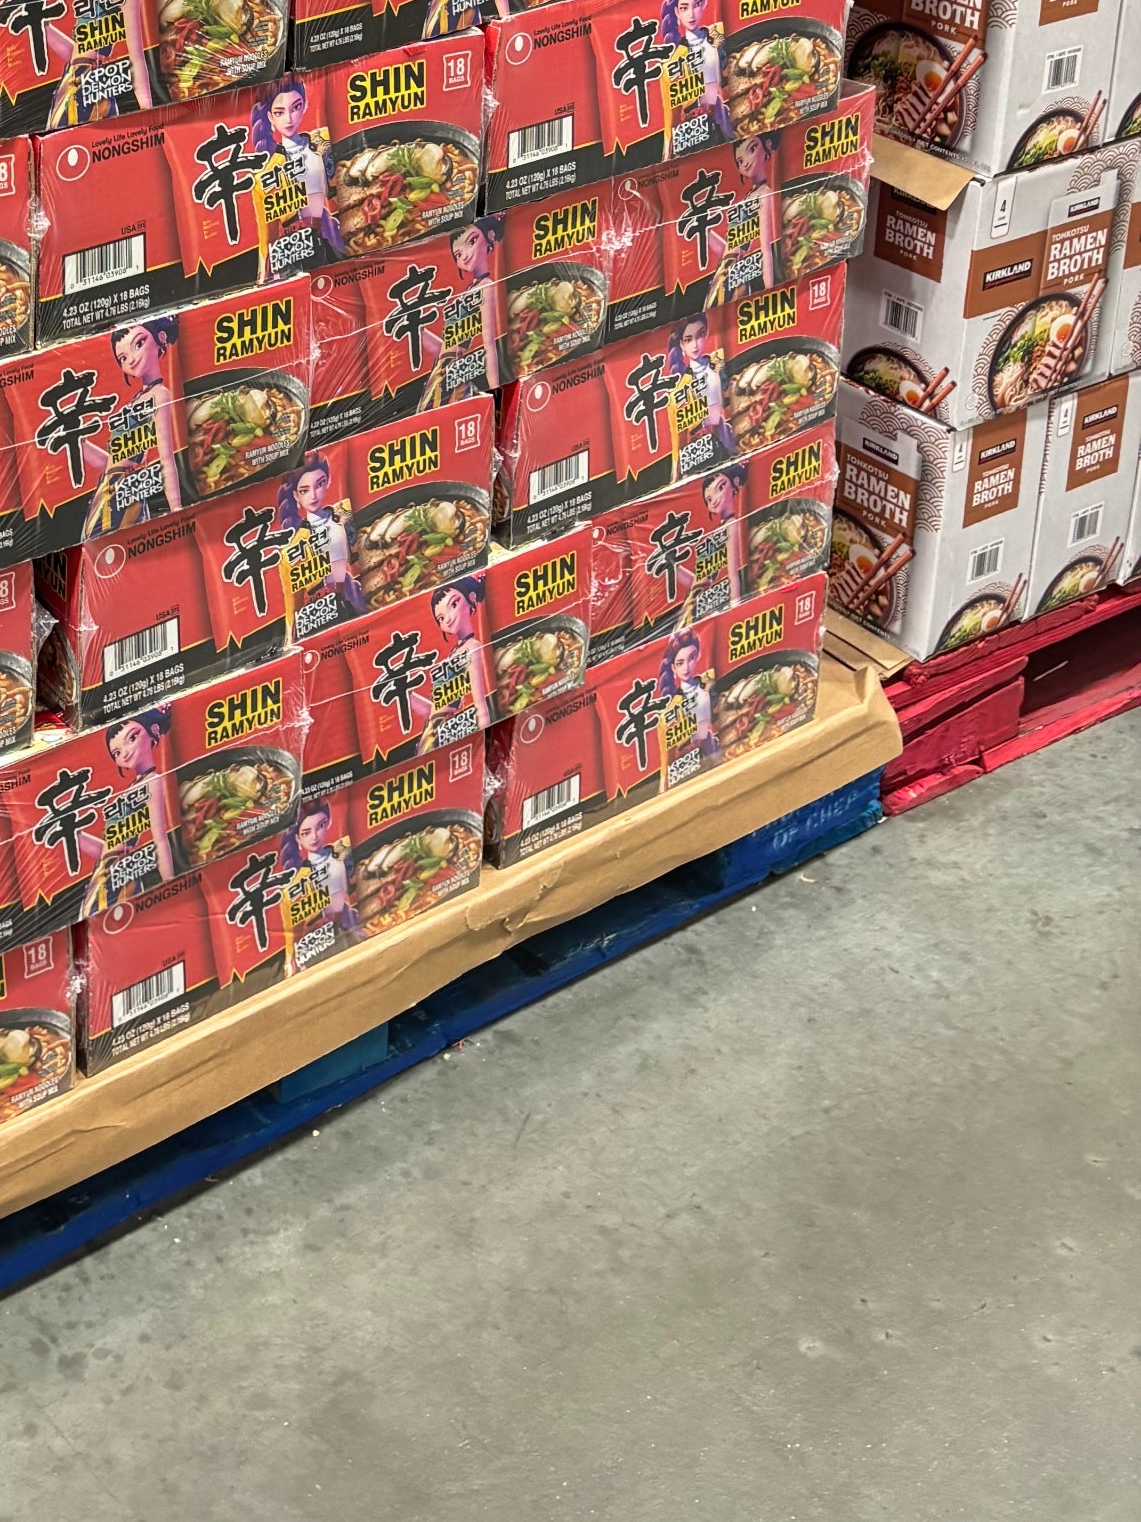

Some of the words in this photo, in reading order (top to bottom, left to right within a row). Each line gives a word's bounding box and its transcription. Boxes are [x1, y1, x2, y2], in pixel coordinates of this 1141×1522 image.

[533, 22, 592, 50] NONGSHIM
[931, 20, 957, 36] PORK
[348, 61, 425, 103] SHIN
[348, 91, 425, 124] RAMYUN
[884, 228, 934, 260] BROTH
[886, 214, 936, 246] RAMEN
[1049, 228, 1108, 261] RAMEN
[1052, 224, 1090, 242] TONKOTSU
[985, 261, 1032, 283] KIRKLAND
[1047, 248, 1104, 280] BROTH
[1063, 273, 1085, 286] PORK
[215, 298, 293, 345] SHIN
[215, 327, 293, 365] RAMYUN
[845, 463, 911, 508] RAMEN
[842, 483, 909, 529] BROTH
[728, 604, 785, 649] SHIN
[729, 628, 784, 663] RAMYUN
[368, 760, 434, 813] SHIN
[368, 786, 434, 830] RAMYUN
